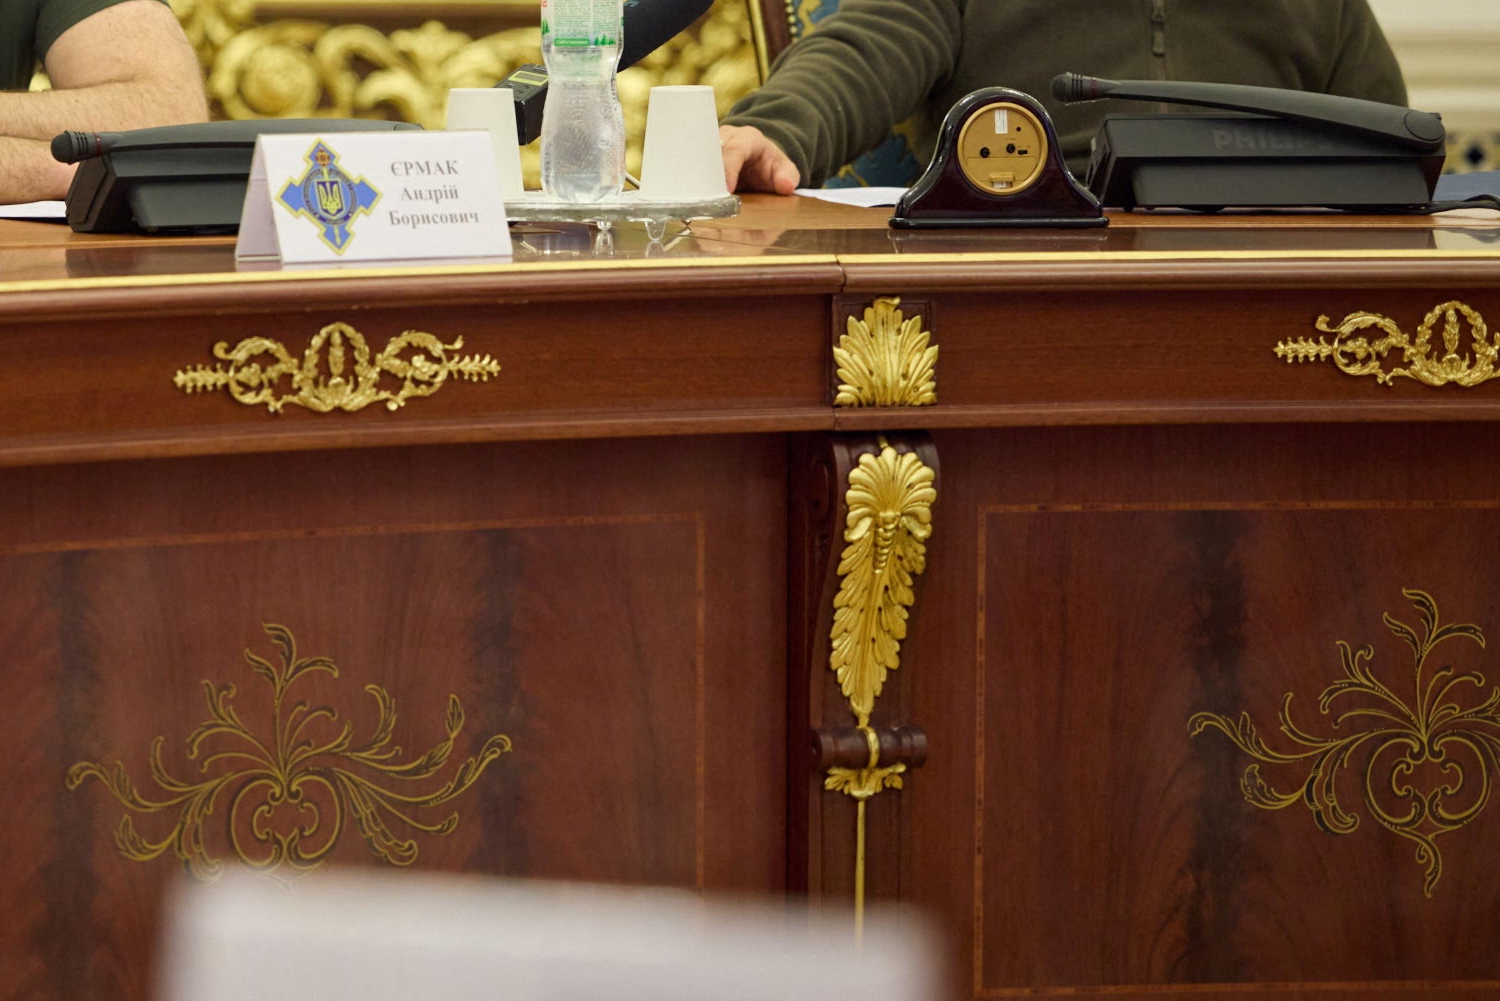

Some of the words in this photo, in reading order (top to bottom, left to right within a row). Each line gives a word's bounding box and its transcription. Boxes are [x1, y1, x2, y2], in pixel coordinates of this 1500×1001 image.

[389, 160, 459, 177] ЄРМАК
[401, 184, 460, 205] Андрій
[389, 209, 479, 230] Борисович
